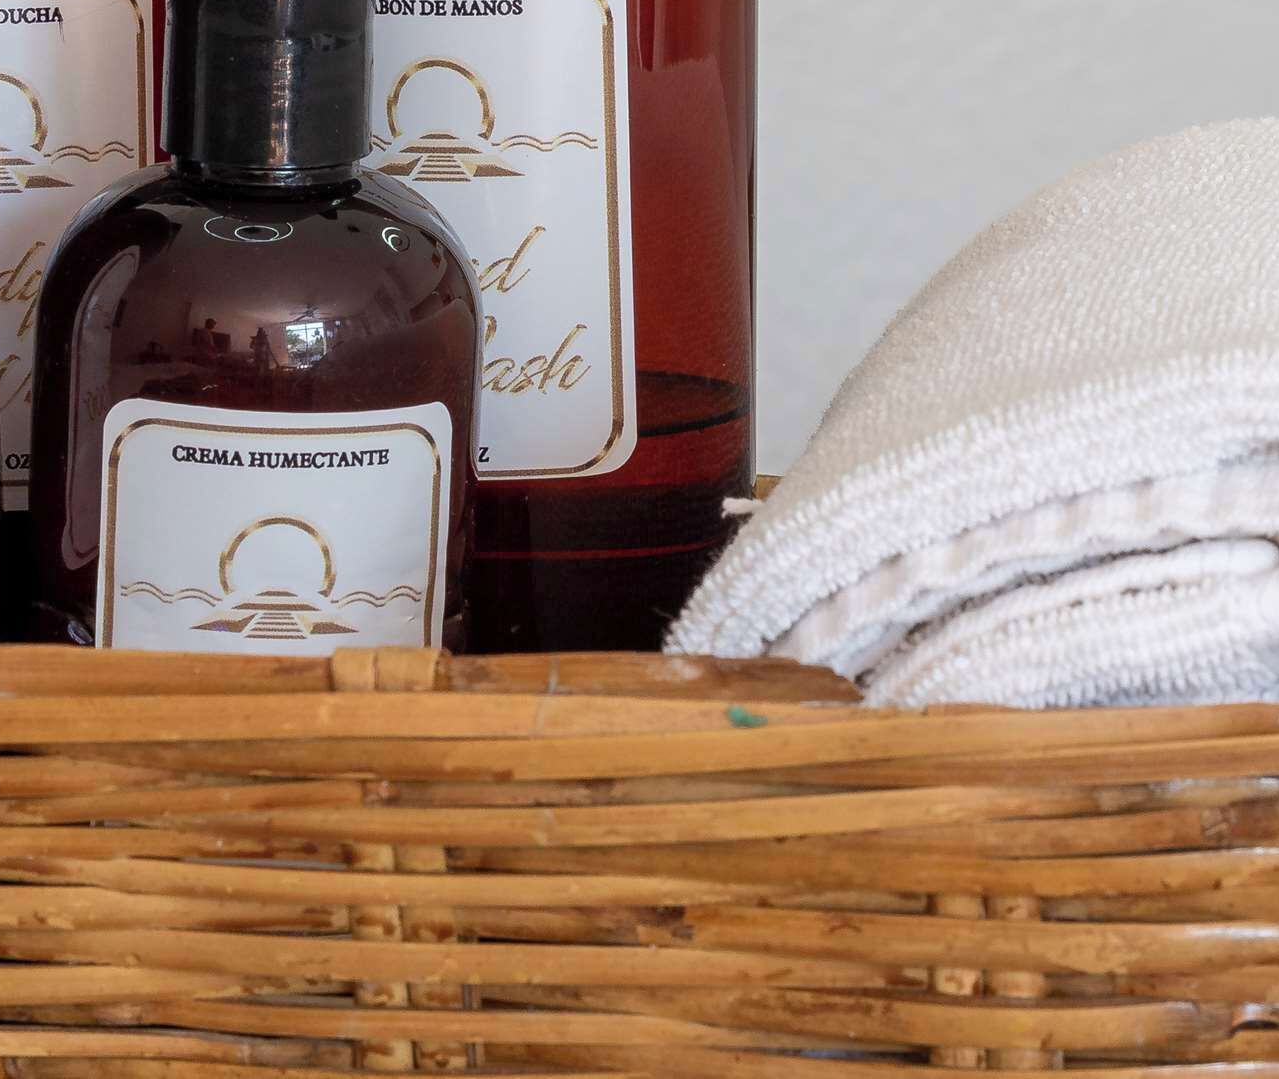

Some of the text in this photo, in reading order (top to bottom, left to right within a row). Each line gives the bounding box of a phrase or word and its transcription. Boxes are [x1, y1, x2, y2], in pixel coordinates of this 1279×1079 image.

[419, 0, 447, 16] DE
[451, 0, 524, 17] MANOS
[481, 315, 592, 395] ash
[5, 453, 31, 470] OZ
[171, 444, 390, 469] CREMA HUMECTANTE
[478, 446, 490, 463] Z
